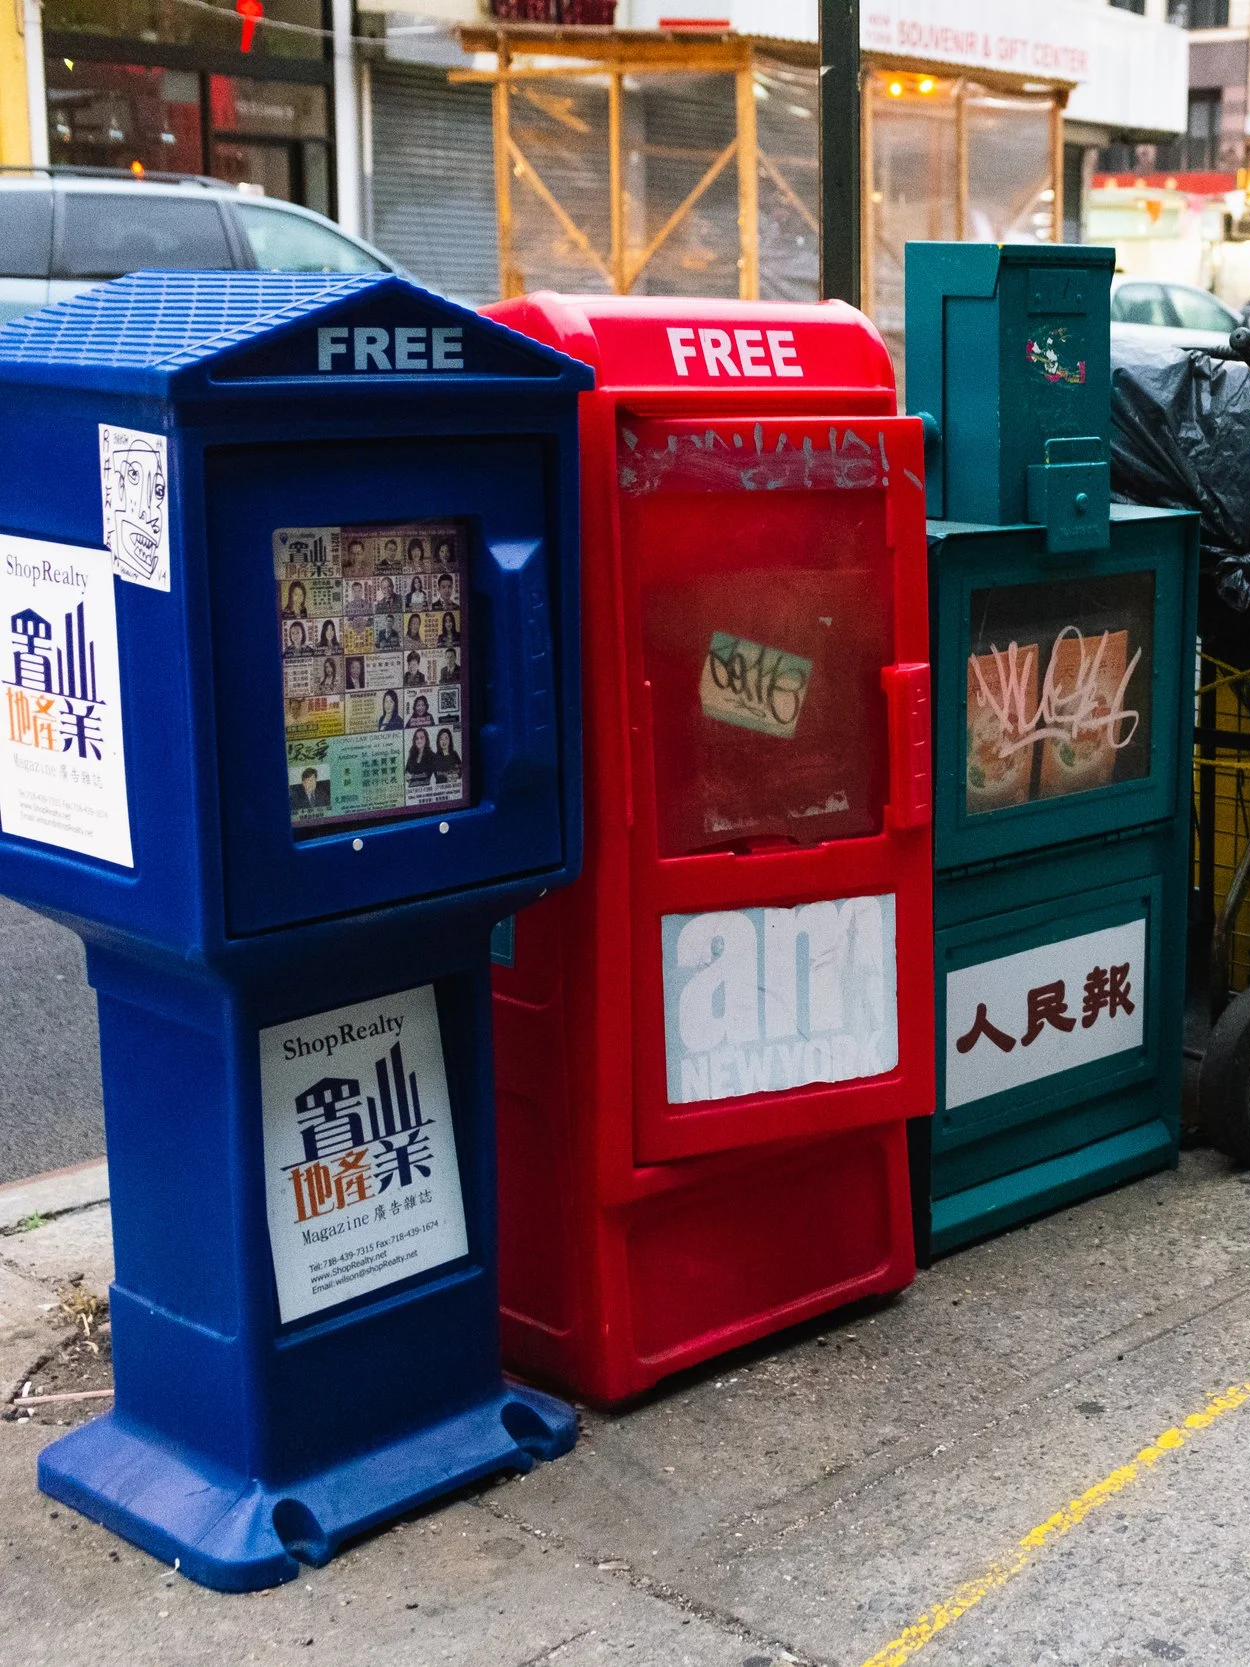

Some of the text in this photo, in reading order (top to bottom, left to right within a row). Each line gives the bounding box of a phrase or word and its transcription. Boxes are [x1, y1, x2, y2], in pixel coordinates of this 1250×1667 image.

[897, 19, 1088, 72] SOUVENIR & GIFT CENTER
[317, 327, 464, 371] FREE
[666, 327, 804, 377] FREE
[6, 554, 88, 588] ShopRealty
[14, 753, 57, 777] Magazine
[956, 962, 1135, 1054] 人民報
[283, 1015, 404, 1060] ShopRealty
[302, 1189, 433, 1245] Magazine 廣告雜誌
[309, 1219, 439, 1273] Tel:718-439-7315 Fax:718-439-1674
[311, 1250, 387, 1283] www.ShopRealty.net
